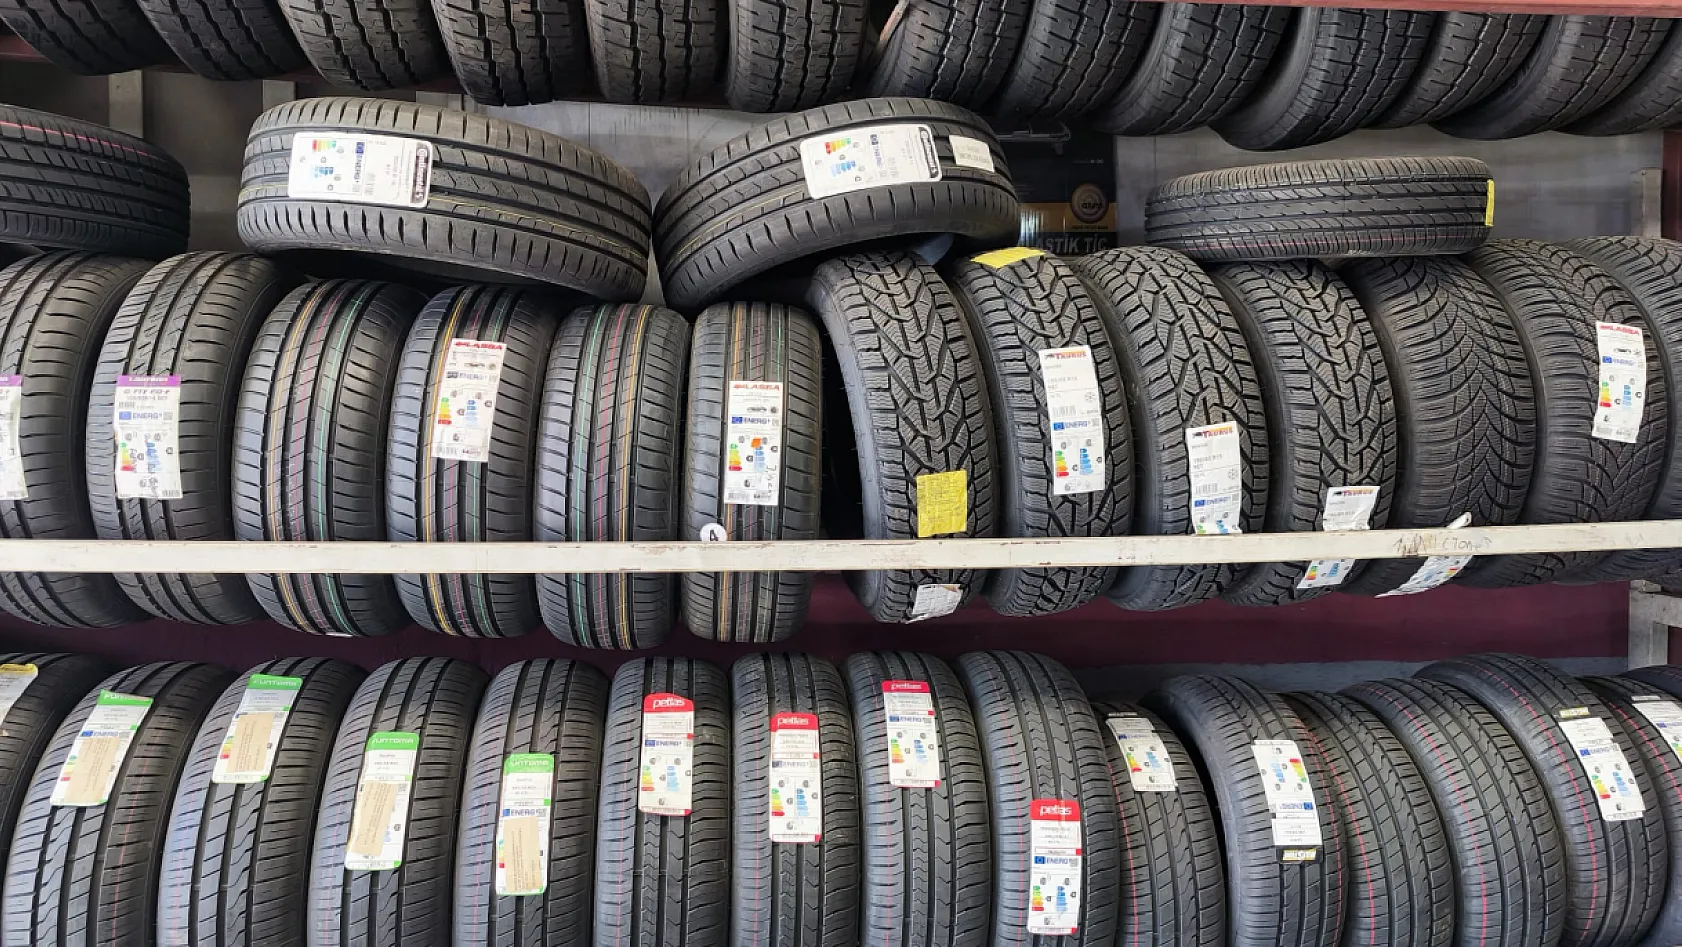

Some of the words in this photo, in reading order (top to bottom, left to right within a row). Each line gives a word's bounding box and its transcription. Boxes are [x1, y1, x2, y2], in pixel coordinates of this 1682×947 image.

[1055, 350, 1087, 360] TAURUS
[1201, 428, 1233, 439] TAURUS
[653, 697, 685, 709] petlas
[1039, 804, 1073, 816] petlas
